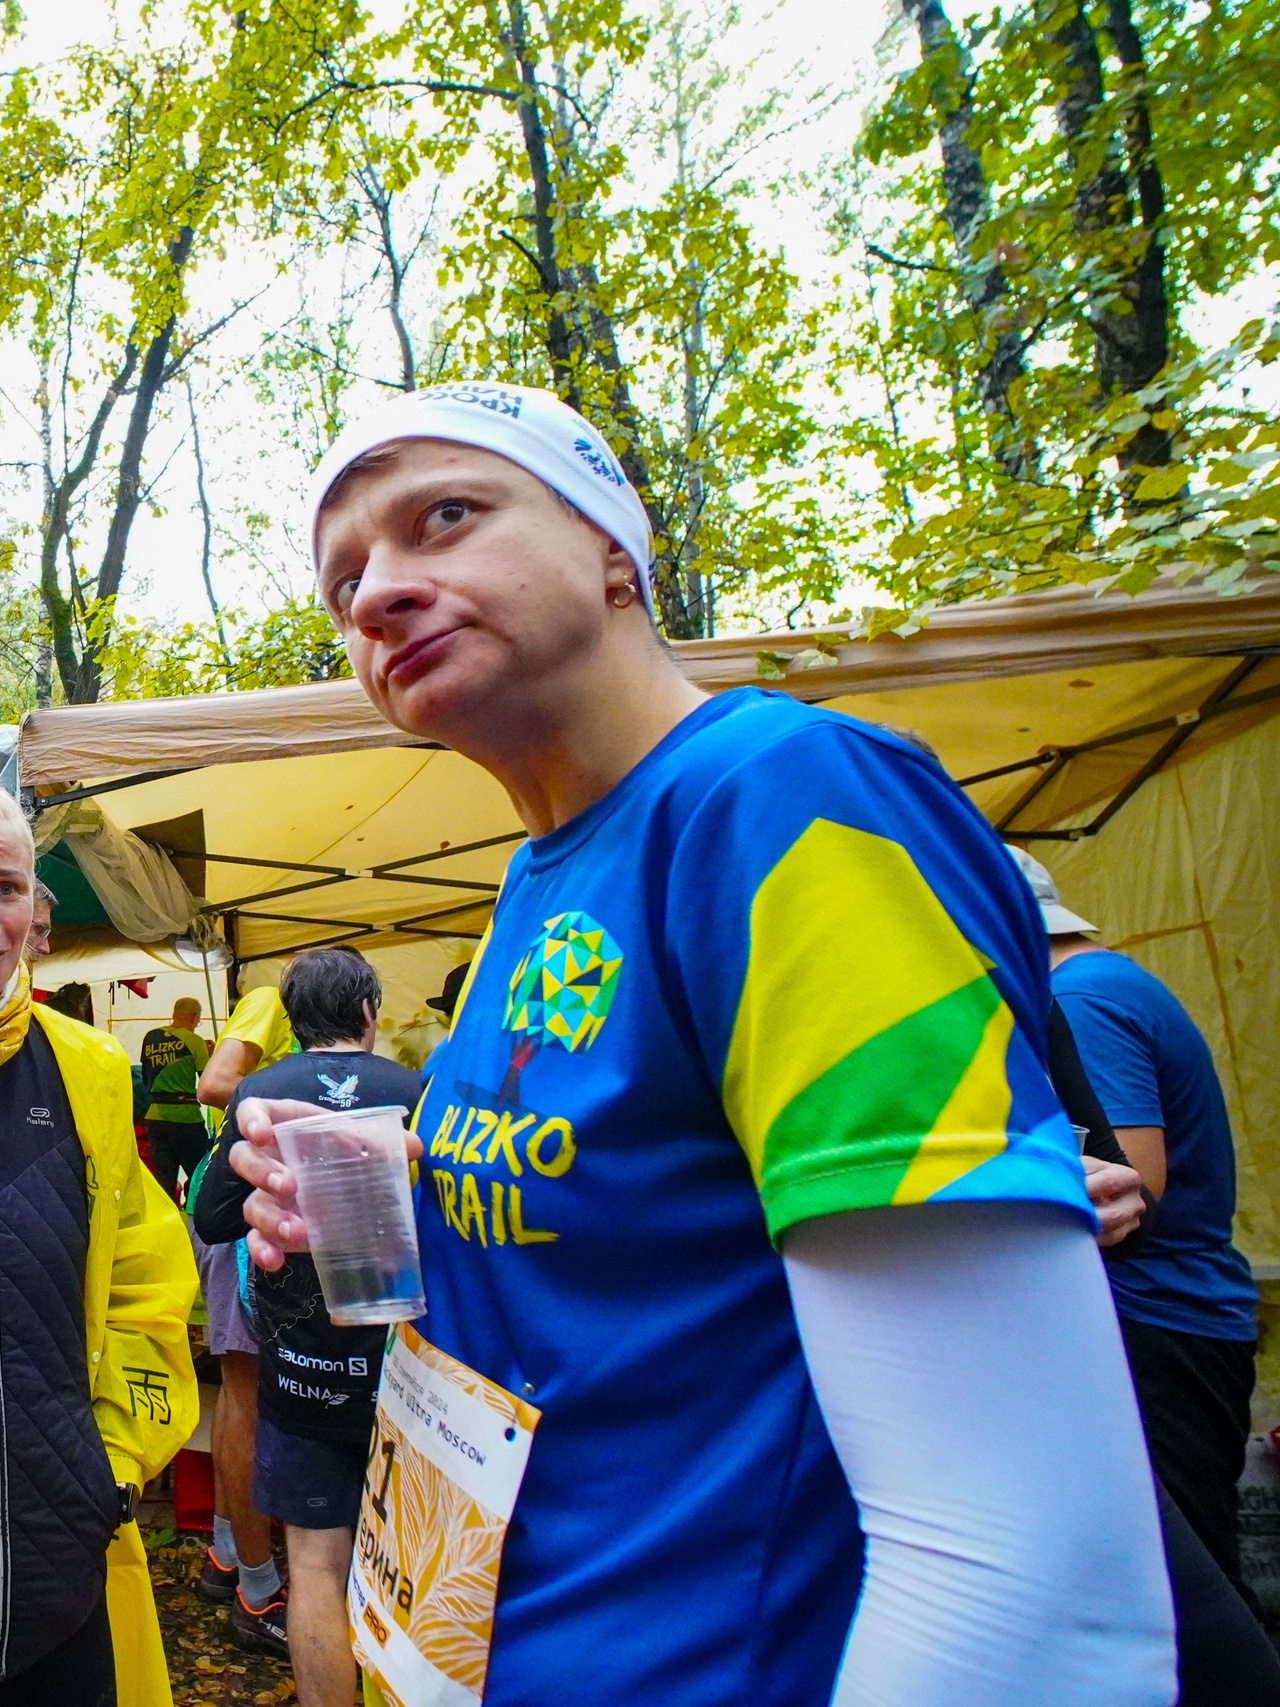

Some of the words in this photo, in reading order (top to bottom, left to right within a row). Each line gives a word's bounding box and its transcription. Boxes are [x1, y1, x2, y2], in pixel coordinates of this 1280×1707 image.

[145, 1040, 185, 1057] BLIZKO
[340, 1099, 352, 1108] 50
[121, 1365, 172, 1426] 雨
[278, 1373, 332, 1401] WELNA
[360, 1518, 414, 1616] ерина
[363, 1607, 389, 1644] PRO
